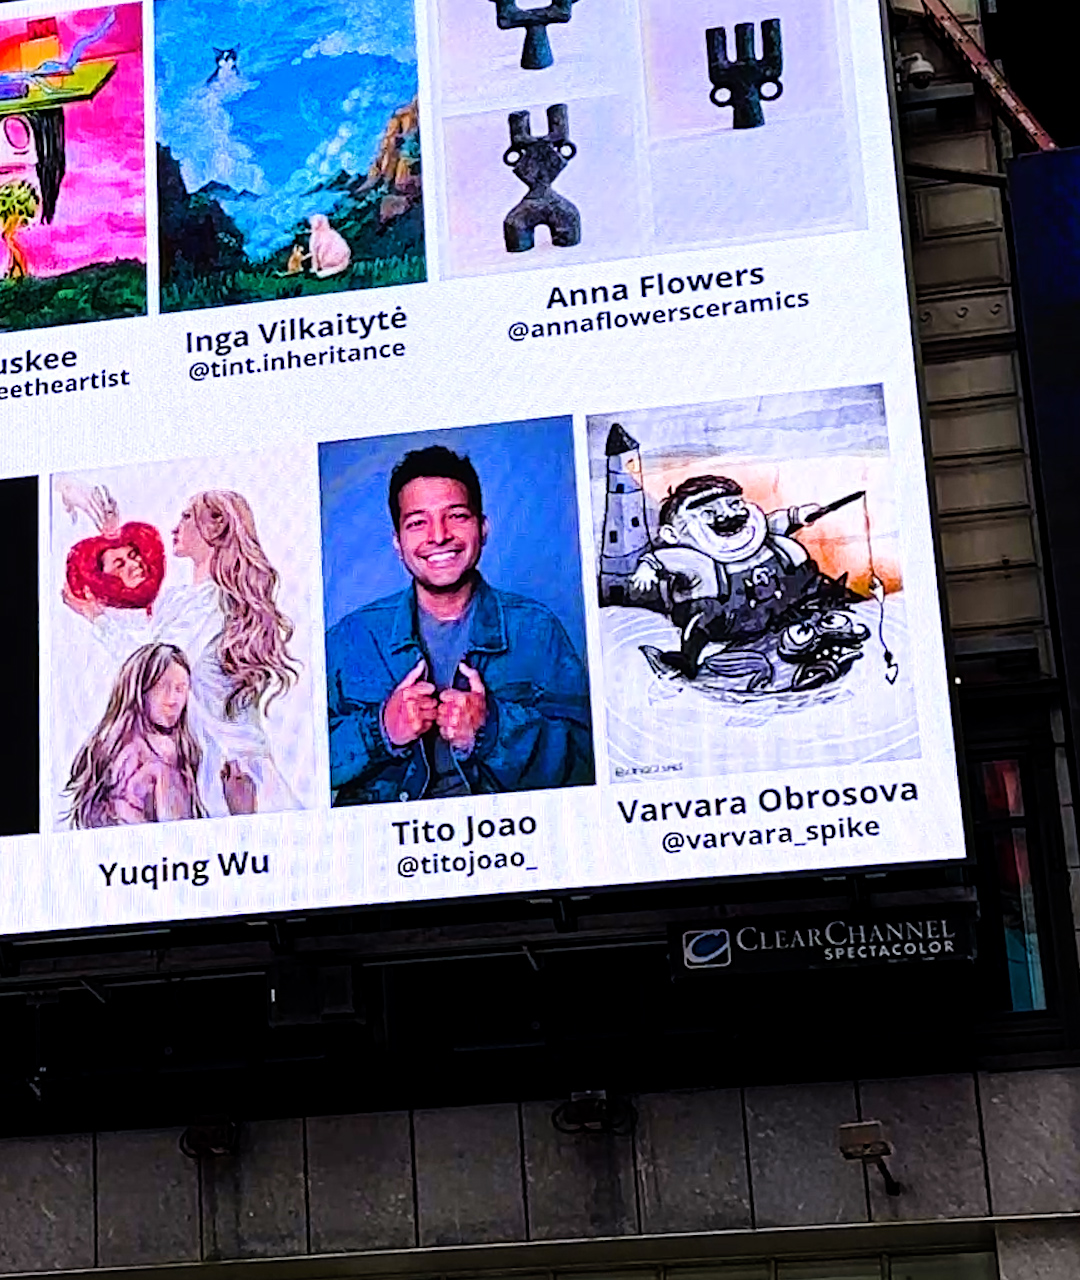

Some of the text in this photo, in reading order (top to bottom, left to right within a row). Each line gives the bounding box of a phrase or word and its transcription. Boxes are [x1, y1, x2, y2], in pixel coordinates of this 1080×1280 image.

[546, 265, 765, 309] Anna Flowers
[185, 306, 408, 357] Inga Vilkaitytė
[508, 290, 809, 342] @annaflowersceramics
[188, 341, 406, 382] @tint.inheritance
[617, 779, 919, 823] Varvara Obrosova
[392, 812, 537, 846] Tito Joao
[661, 816, 881, 855] @varvara_spike
[98, 850, 270, 890] Yuqing Wu
[396, 850, 538, 879] @titojoao_
[824, 940, 954, 960] SPECTACOLOR
